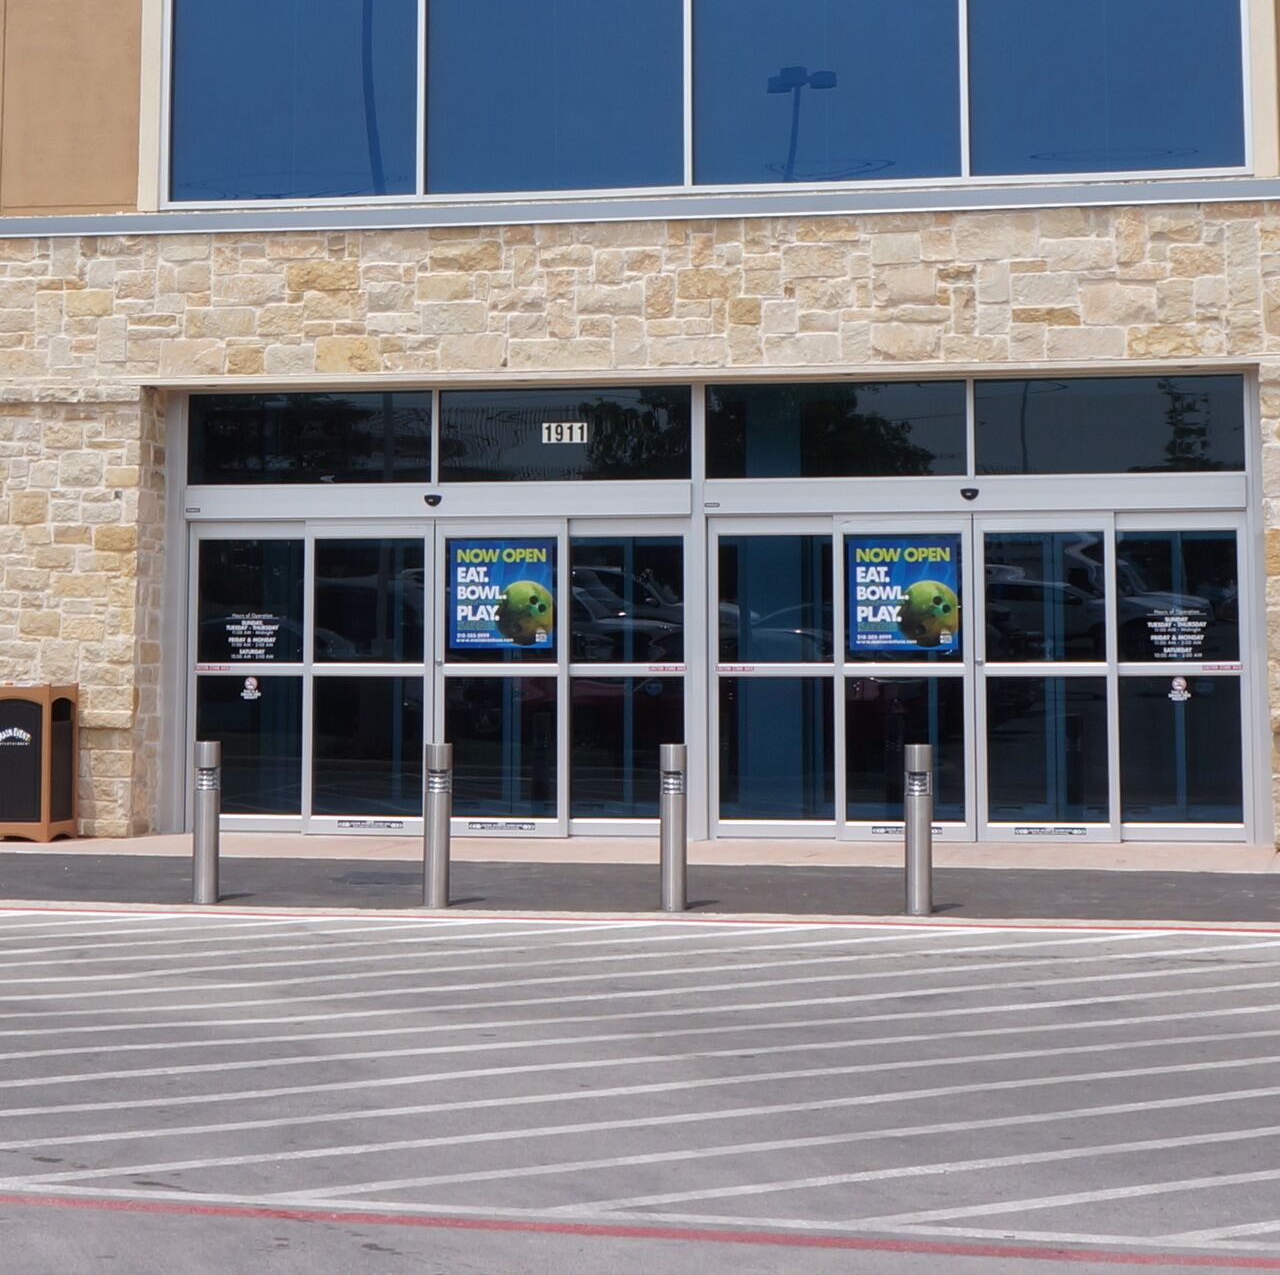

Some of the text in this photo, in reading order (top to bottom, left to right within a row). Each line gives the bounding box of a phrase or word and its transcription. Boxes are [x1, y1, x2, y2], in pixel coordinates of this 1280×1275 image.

[544, 423, 585, 442] 1911
[456, 548, 547, 563] NOW OPEN
[856, 547, 950, 563] NOW OPEN
[457, 566, 489, 583] EAT.
[856, 566, 890, 583] EAT.
[457, 585, 507, 600] BOWL.
[856, 585, 909, 600] BOWL.
[457, 605, 500, 621] PLAY.
[856, 605, 902, 622] PLAY.
[13, 727, 31, 741] EVENT
